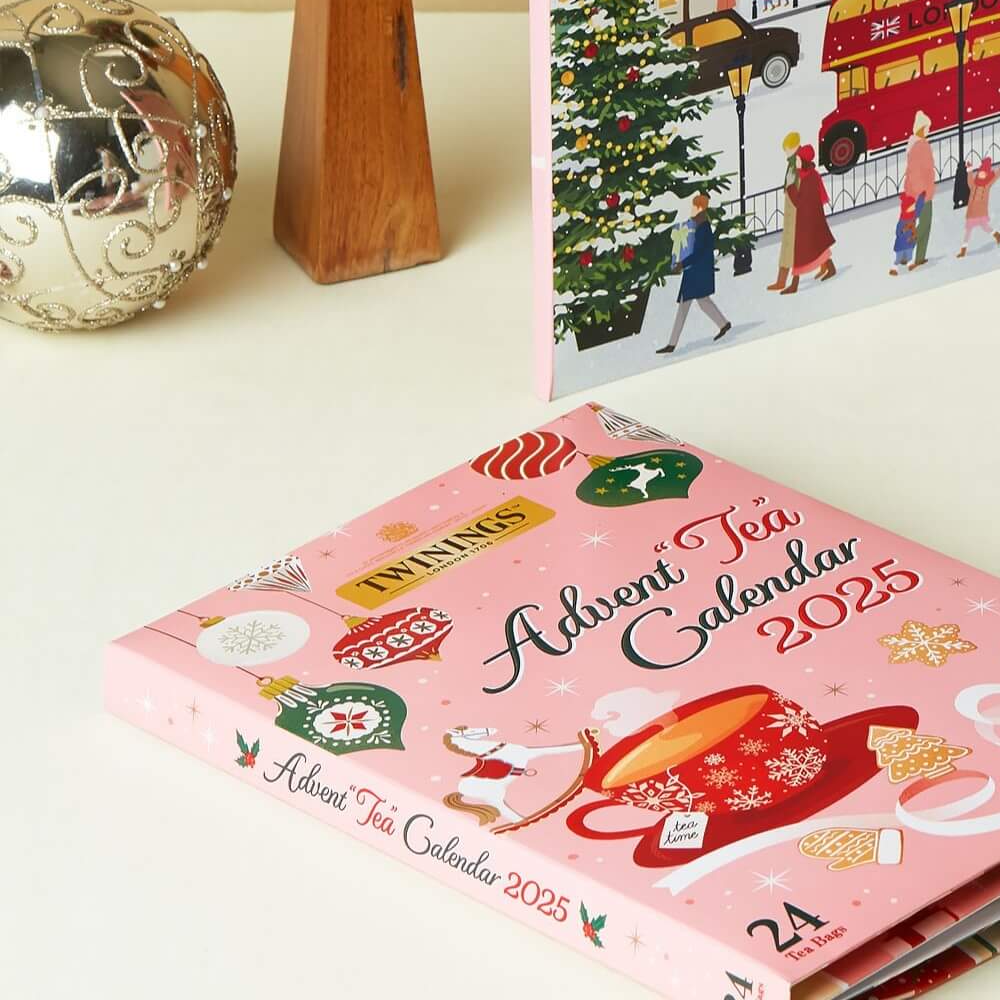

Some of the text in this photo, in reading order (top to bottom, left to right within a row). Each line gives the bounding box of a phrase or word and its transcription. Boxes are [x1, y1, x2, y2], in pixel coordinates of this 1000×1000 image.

[356, 504, 526, 593] TWININGS
[426, 553, 468, 577] LONDON
[470, 540, 494, 555] 1706
[483, 559, 686, 694] Advent
[621, 538, 858, 669] Calendar
[757, 558, 921, 654] 2025
[263, 753, 347, 811] Advent
[403, 814, 502, 886] Calendar
[504, 872, 571, 922] 2025
[664, 831, 699, 845] time
[673, 820, 698, 832] tea
[746, 901, 831, 953] 24
[784, 926, 848, 962] Tea Bags
[724, 970, 754, 1000] 4
